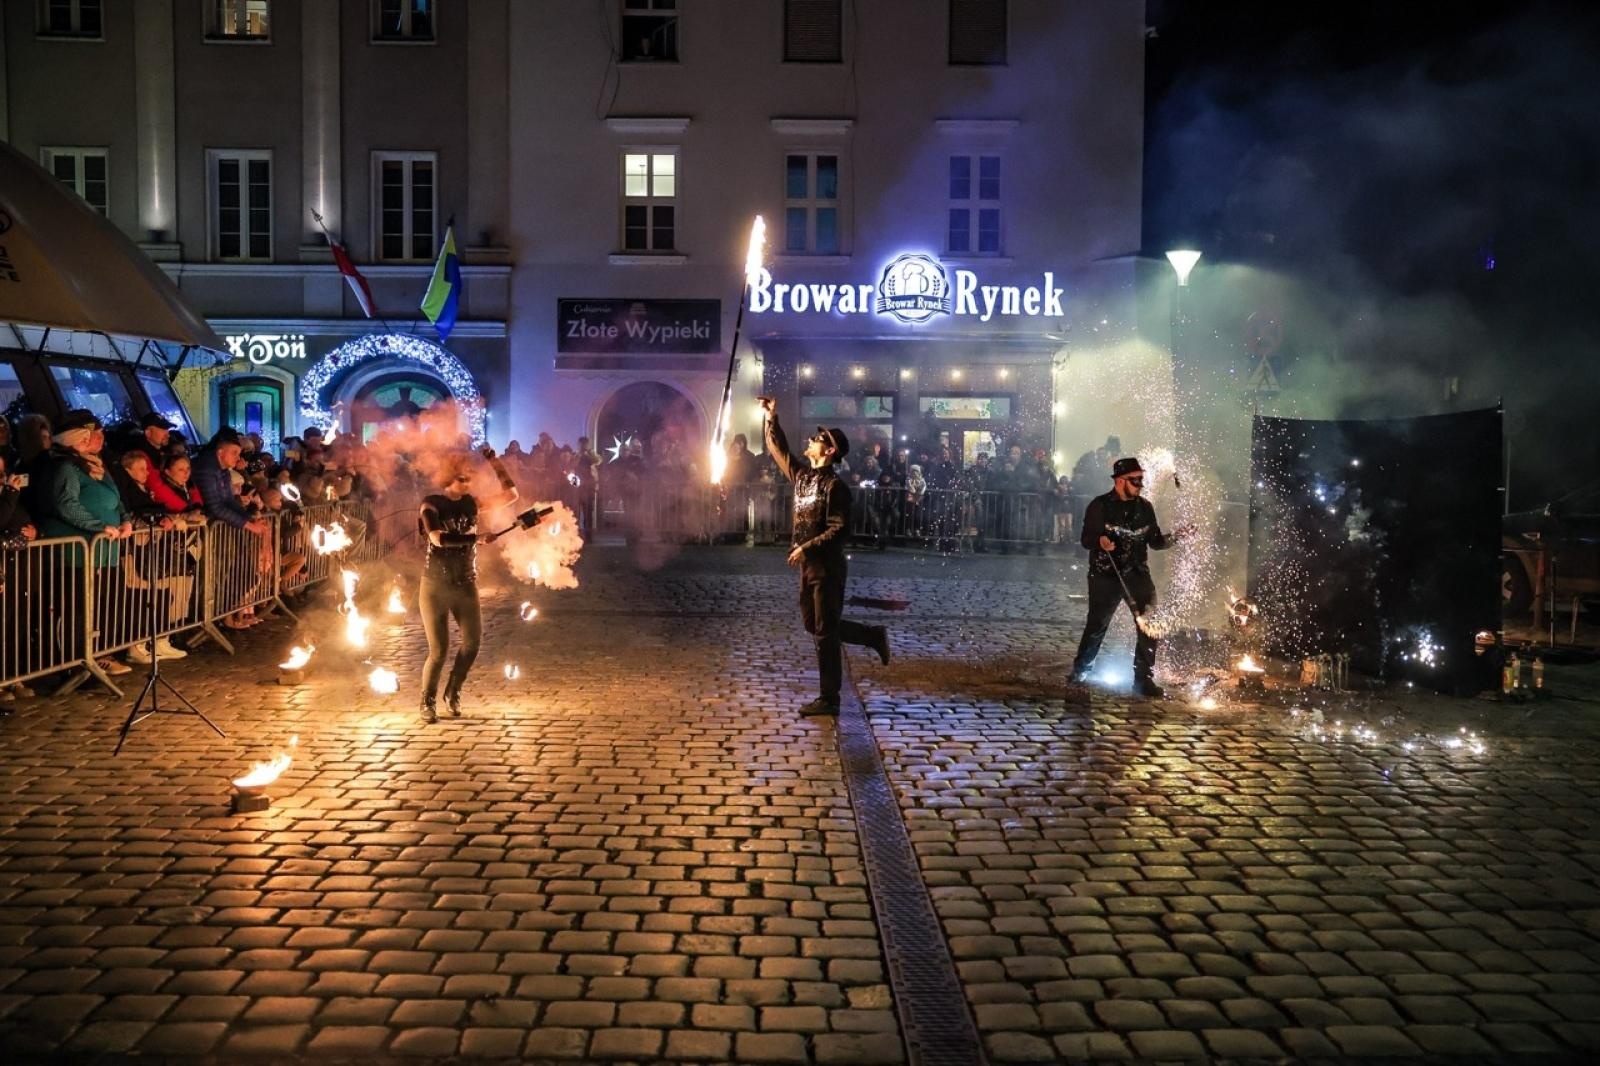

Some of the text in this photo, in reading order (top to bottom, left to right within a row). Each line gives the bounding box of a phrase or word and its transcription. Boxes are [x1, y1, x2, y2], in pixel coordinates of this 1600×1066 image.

[749, 266, 1065, 321] Browar Rynek
[886, 297, 942, 311] Browar Rynek
[567, 318, 711, 344] Złote Wypieki
